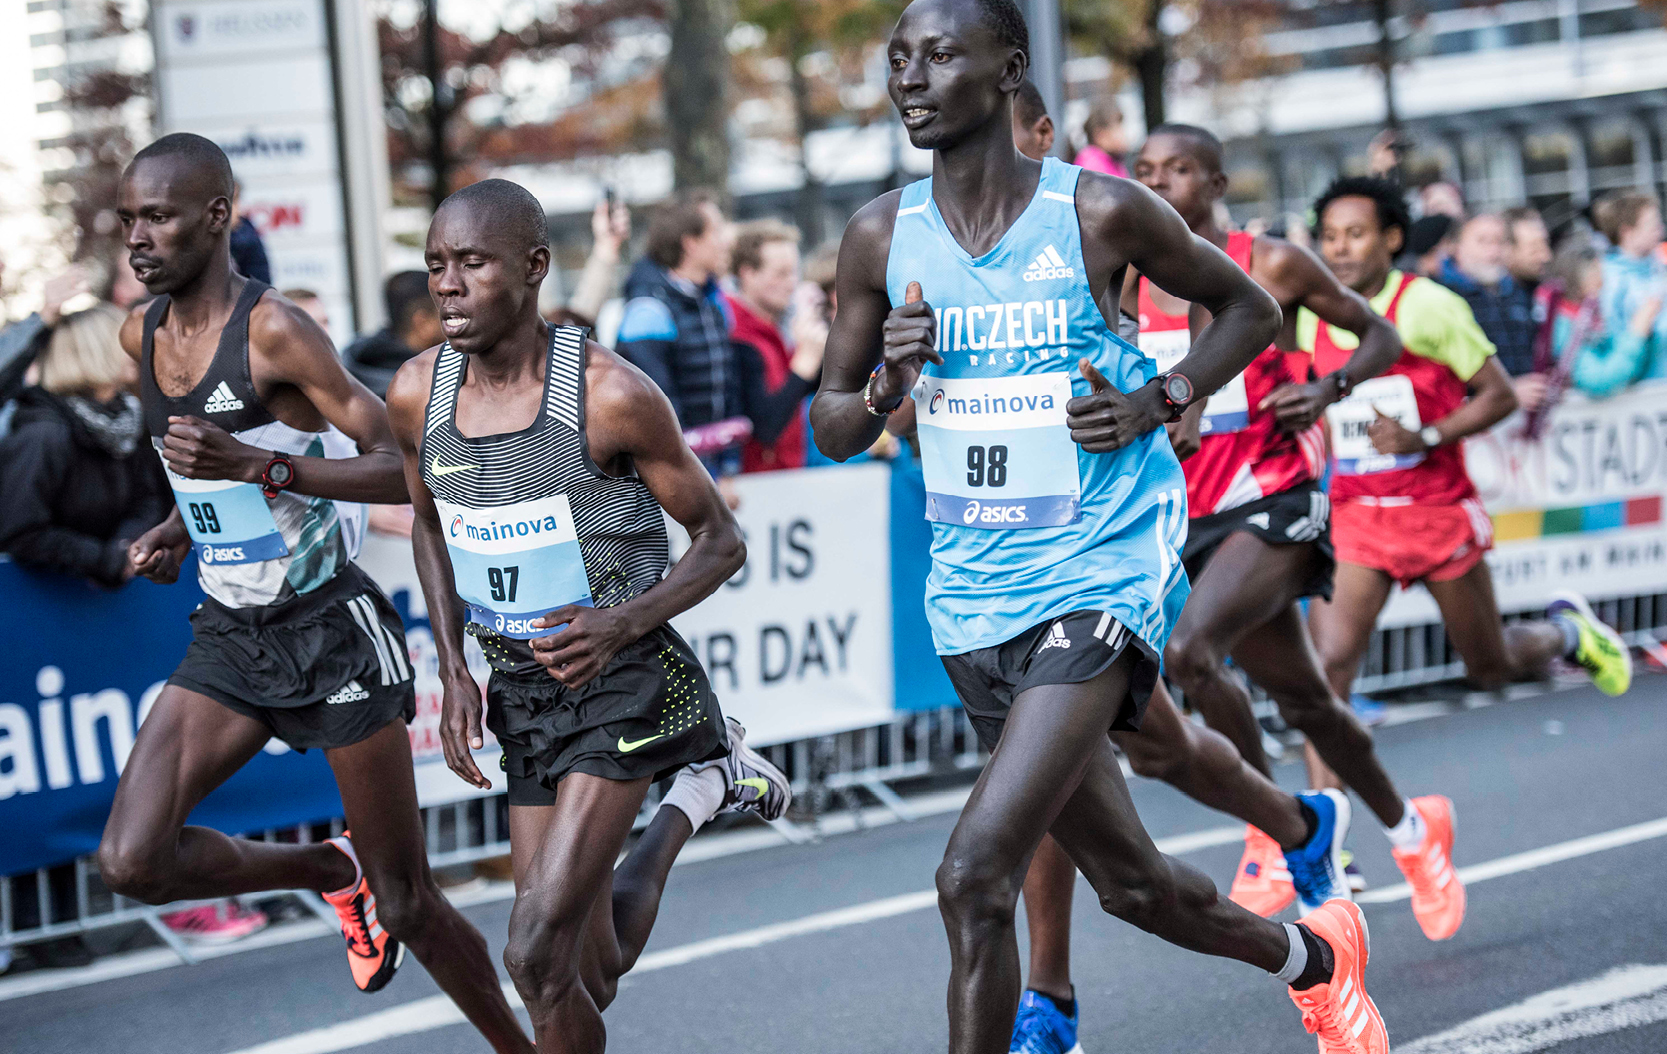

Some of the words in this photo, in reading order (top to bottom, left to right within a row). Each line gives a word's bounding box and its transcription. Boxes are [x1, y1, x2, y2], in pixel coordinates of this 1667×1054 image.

[1023, 266, 1074, 282] adidas
[969, 346, 1069, 366] RACING
[204, 399, 244, 414] adidas
[948, 393, 1054, 415] mainova
[967, 445, 1008, 488] 98
[188, 502, 221, 534] 99
[980, 505, 1026, 523] asics
[466, 515, 557, 541] mainova
[213, 547, 245, 561] asics
[770, 518, 815, 583] IS
[487, 565, 519, 602] 97
[760, 613, 857, 684] DAY
[326, 690, 370, 704] adidas
